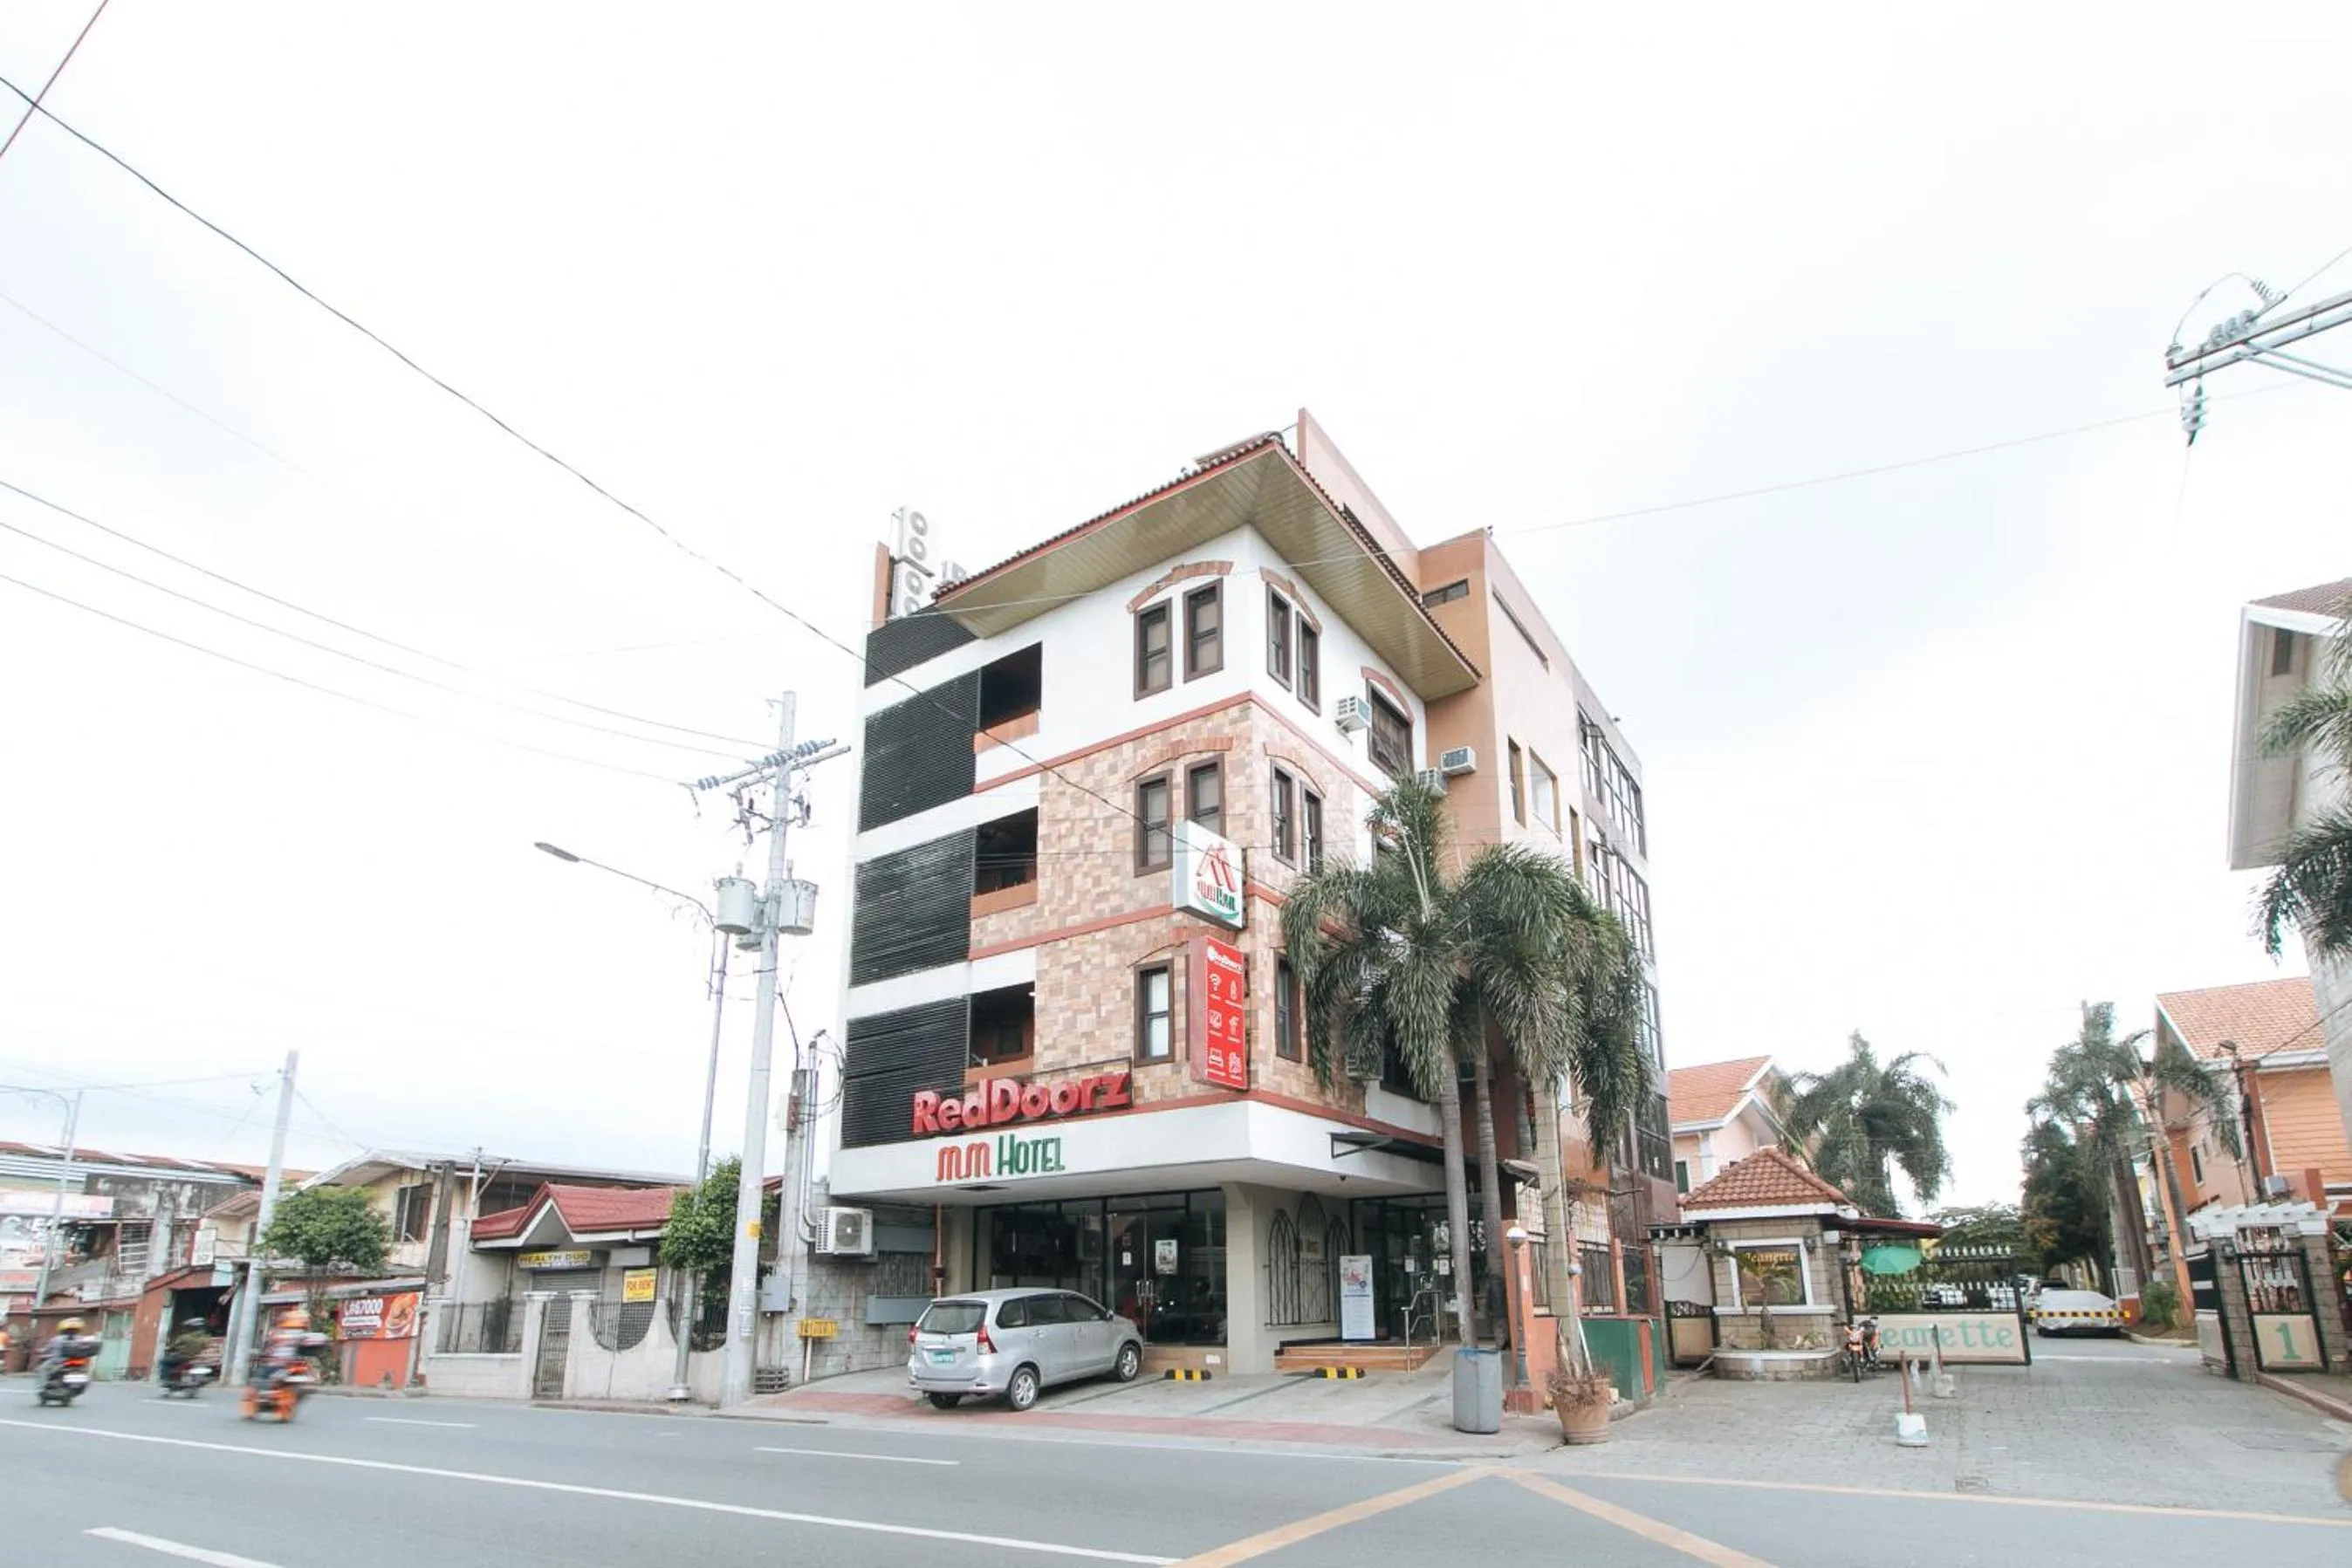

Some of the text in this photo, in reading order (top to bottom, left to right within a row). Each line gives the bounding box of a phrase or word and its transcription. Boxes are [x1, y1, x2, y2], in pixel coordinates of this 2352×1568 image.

[912, 1073, 1131, 1133] RedDoorz
[936, 1141, 991, 1181] MM
[1881, 1318, 2015, 1349] eanette
[2275, 1321, 2302, 1360] 1
